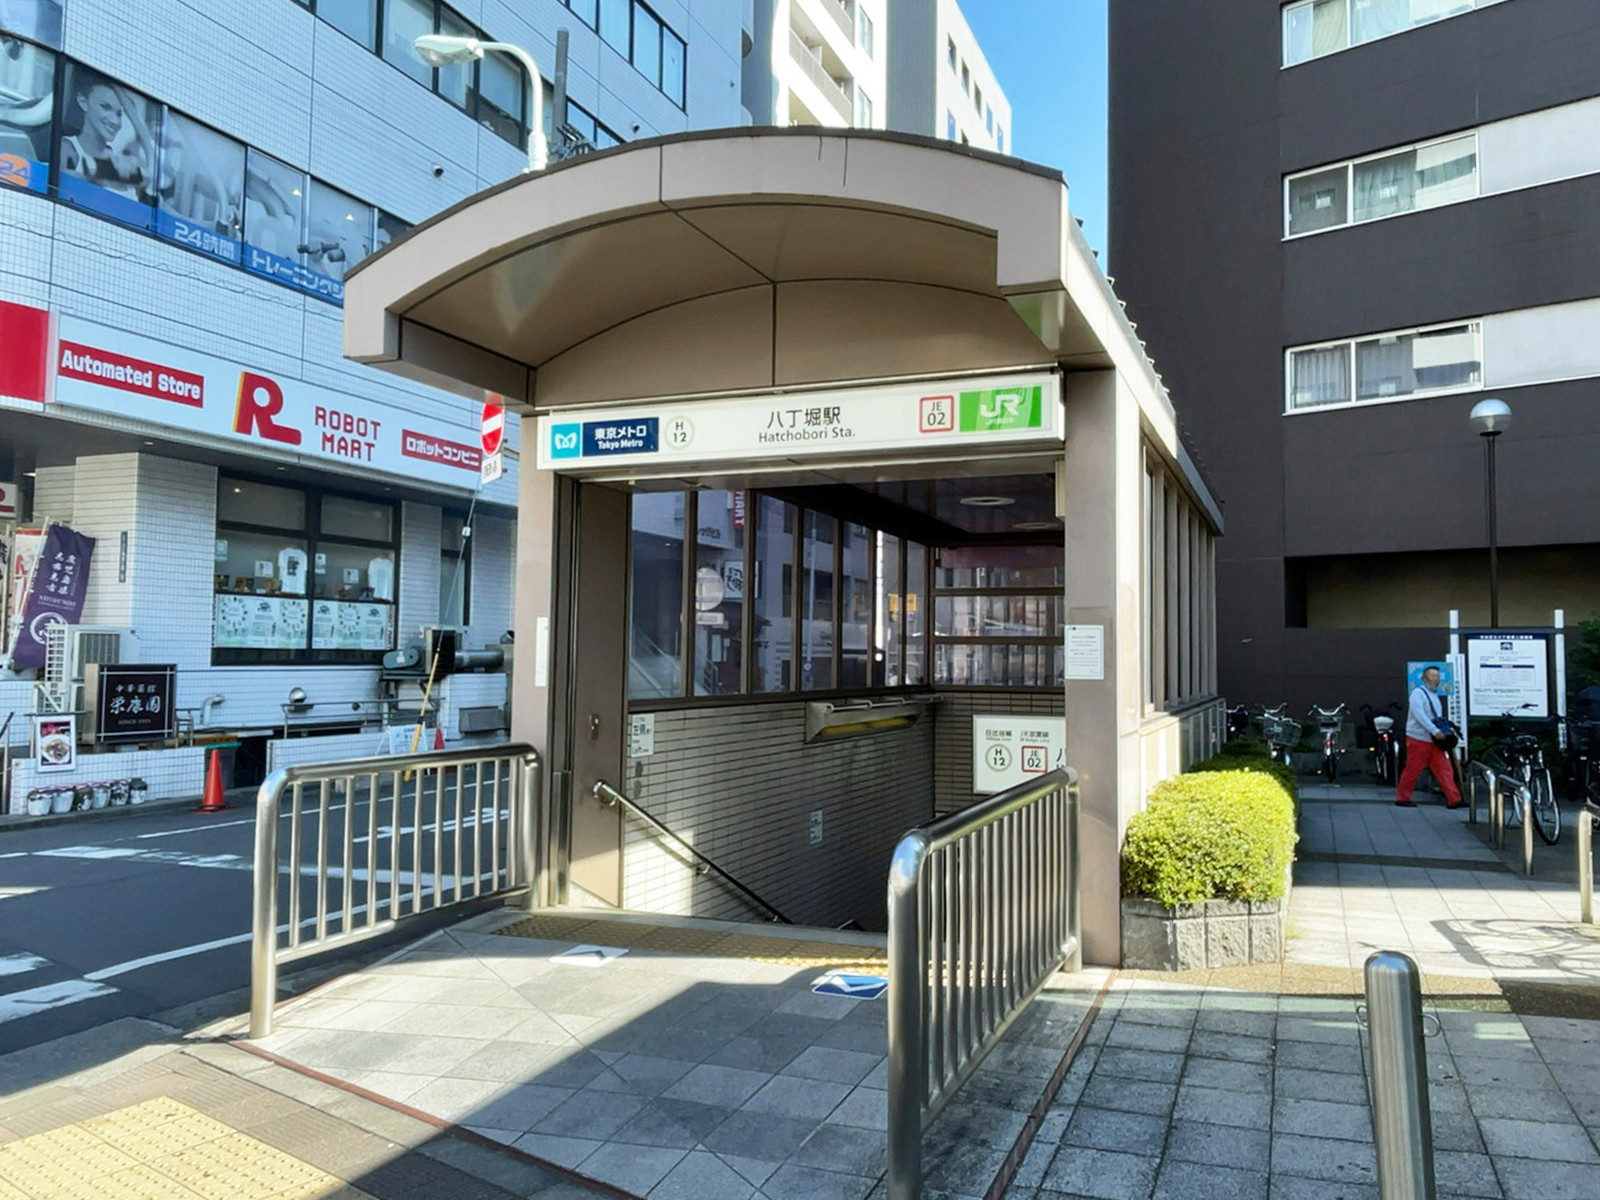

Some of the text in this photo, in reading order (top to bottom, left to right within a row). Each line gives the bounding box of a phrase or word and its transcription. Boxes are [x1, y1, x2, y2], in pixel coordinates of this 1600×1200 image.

[174, 221, 235, 260] 24時間
[61, 349, 201, 400] Automated Store
[233, 371, 302, 446] R
[931, 401, 942, 411] JE
[980, 394, 1019, 418] JR
[314, 406, 381, 441] ROBOT
[767, 406, 841, 429] 八丁堀駅
[927, 412, 946, 426] 02
[595, 425, 647, 440] 東京メトロ
[676, 422, 683, 430] H
[673, 432, 687, 443] 12
[758, 426, 856, 443] Hatchobori Sta.
[322, 432, 376, 462] MART
[406, 436, 480, 467] ロボットコンビニ
[597, 440, 643, 450] Tokyo Metro
[995, 748, 1003, 756] H
[993, 757, 1006, 766] 12
[1027, 757, 1042, 768] 02
